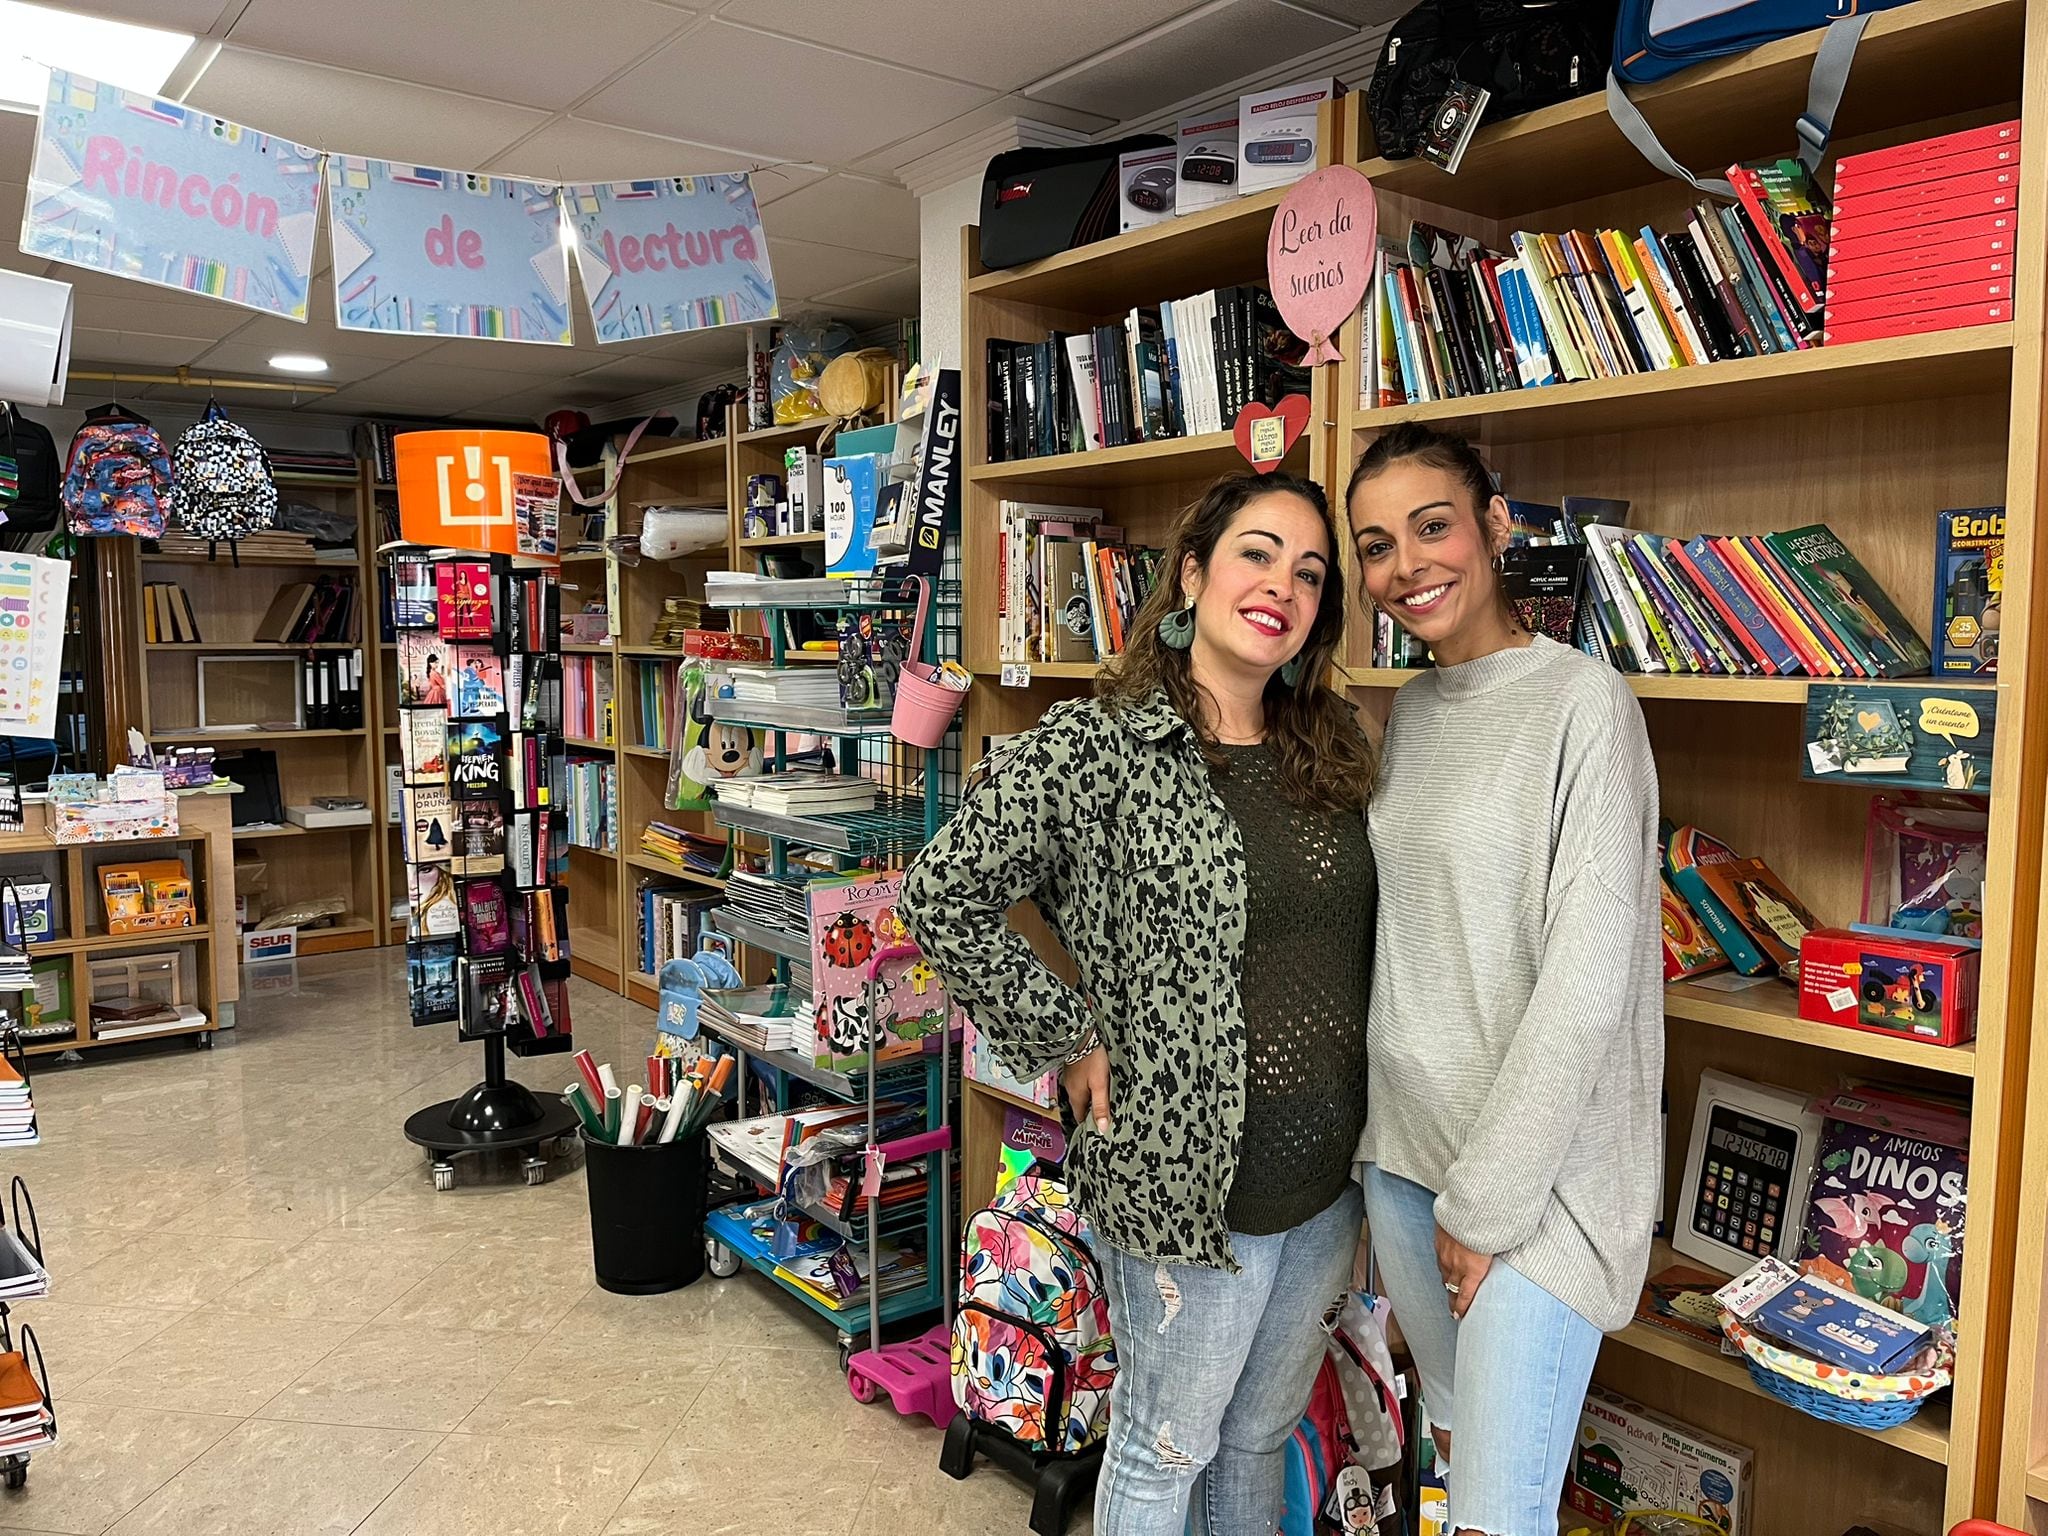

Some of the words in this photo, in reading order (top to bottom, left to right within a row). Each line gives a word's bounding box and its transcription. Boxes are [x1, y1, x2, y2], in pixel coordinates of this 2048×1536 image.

[82, 134, 278, 238] Rincón
[425, 214, 486, 269] de
[603, 222, 758, 276] lectura
[1279, 209, 1324, 257] Leer
[1330, 198, 1353, 235] da
[1290, 259, 1343, 298] sueños
[922, 401, 959, 526] MANLEY
[830, 501, 846, 513] 100
[1952, 514, 2005, 537] Bob
[1794, 533, 1825, 549] ESENCIA
[1792, 543, 1846, 567] MONSTRUO
[1071, 571, 1086, 590] Pa
[404, 645, 442, 658] LONDON
[511, 660, 522, 687] HOPELESS
[1927, 705, 1971, 719] ¡Cuéntame
[1926, 719, 1937, 727] un
[1938, 717, 1970, 730] cuento!
[454, 761, 498, 782] KING
[416, 799, 451, 808] ORUÑA
[847, 883, 892, 901] ROOM
[1701, 899, 1727, 934] VEHICULOS
[249, 933, 293, 949] SEUR
[1012, 1129, 1053, 1148] MINNIE
[1883, 1137, 1943, 1163] AMIGOS
[1848, 1146, 1967, 1207] DINOS
[1733, 1218, 1739, 1226] 2
[1583, 1402, 1627, 1427] LPINO
[1627, 1425, 1660, 1446] Activity
[1662, 1432, 1680, 1444] Pinta
[1681, 1441, 1694, 1453] por
[1695, 1447, 1727, 1467] números
